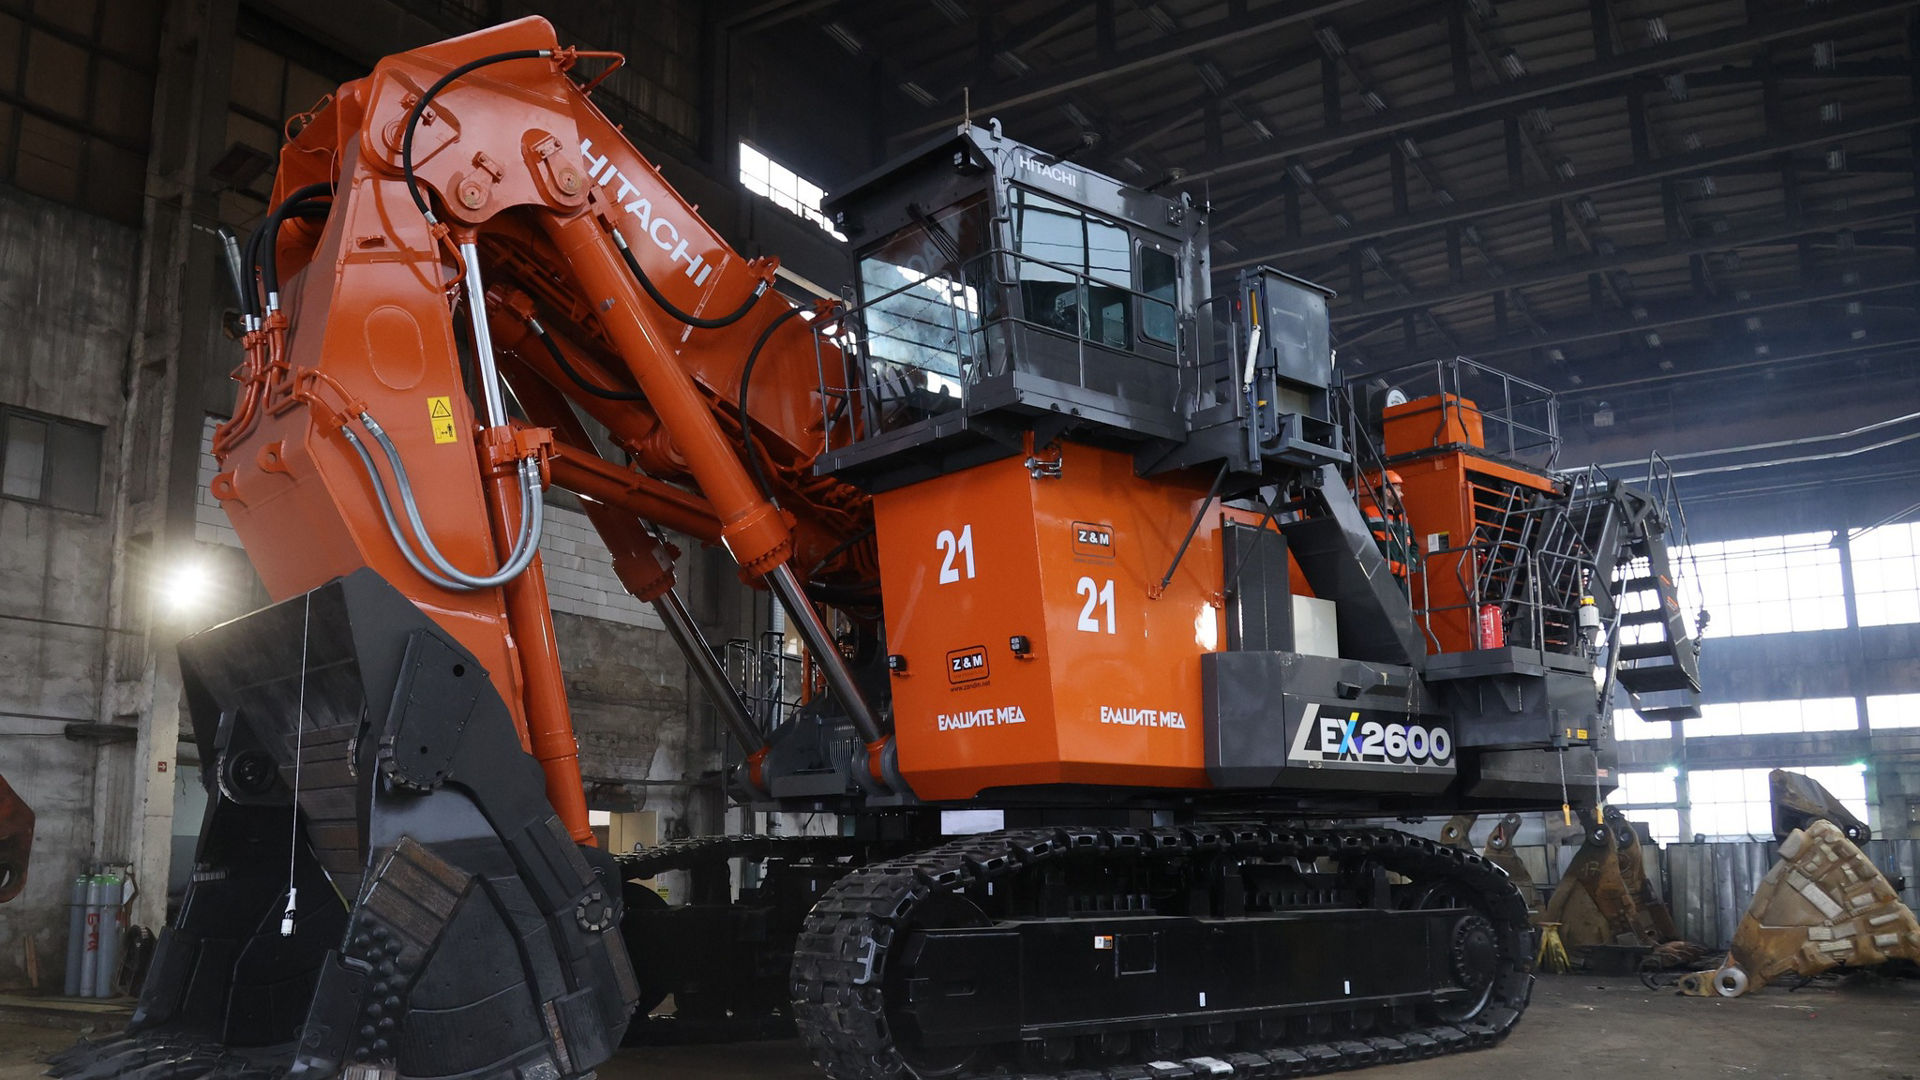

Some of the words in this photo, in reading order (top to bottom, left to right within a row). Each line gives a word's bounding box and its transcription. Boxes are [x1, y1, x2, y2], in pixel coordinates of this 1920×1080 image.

[1020, 155, 1076, 187] HITACHI
[580, 138, 713, 287] HITACHI
[936, 524, 976, 585] 21
[1076, 576, 1116, 635] 21
[937, 708, 995, 731] ЕЛАЦИТЕ
[996, 705, 1027, 725] МЕД
[1100, 706, 1157, 727] ЕЛАЦИТЕ
[1160, 710, 1186, 729] МЕД
[1320, 711, 1451, 762] EX2600
